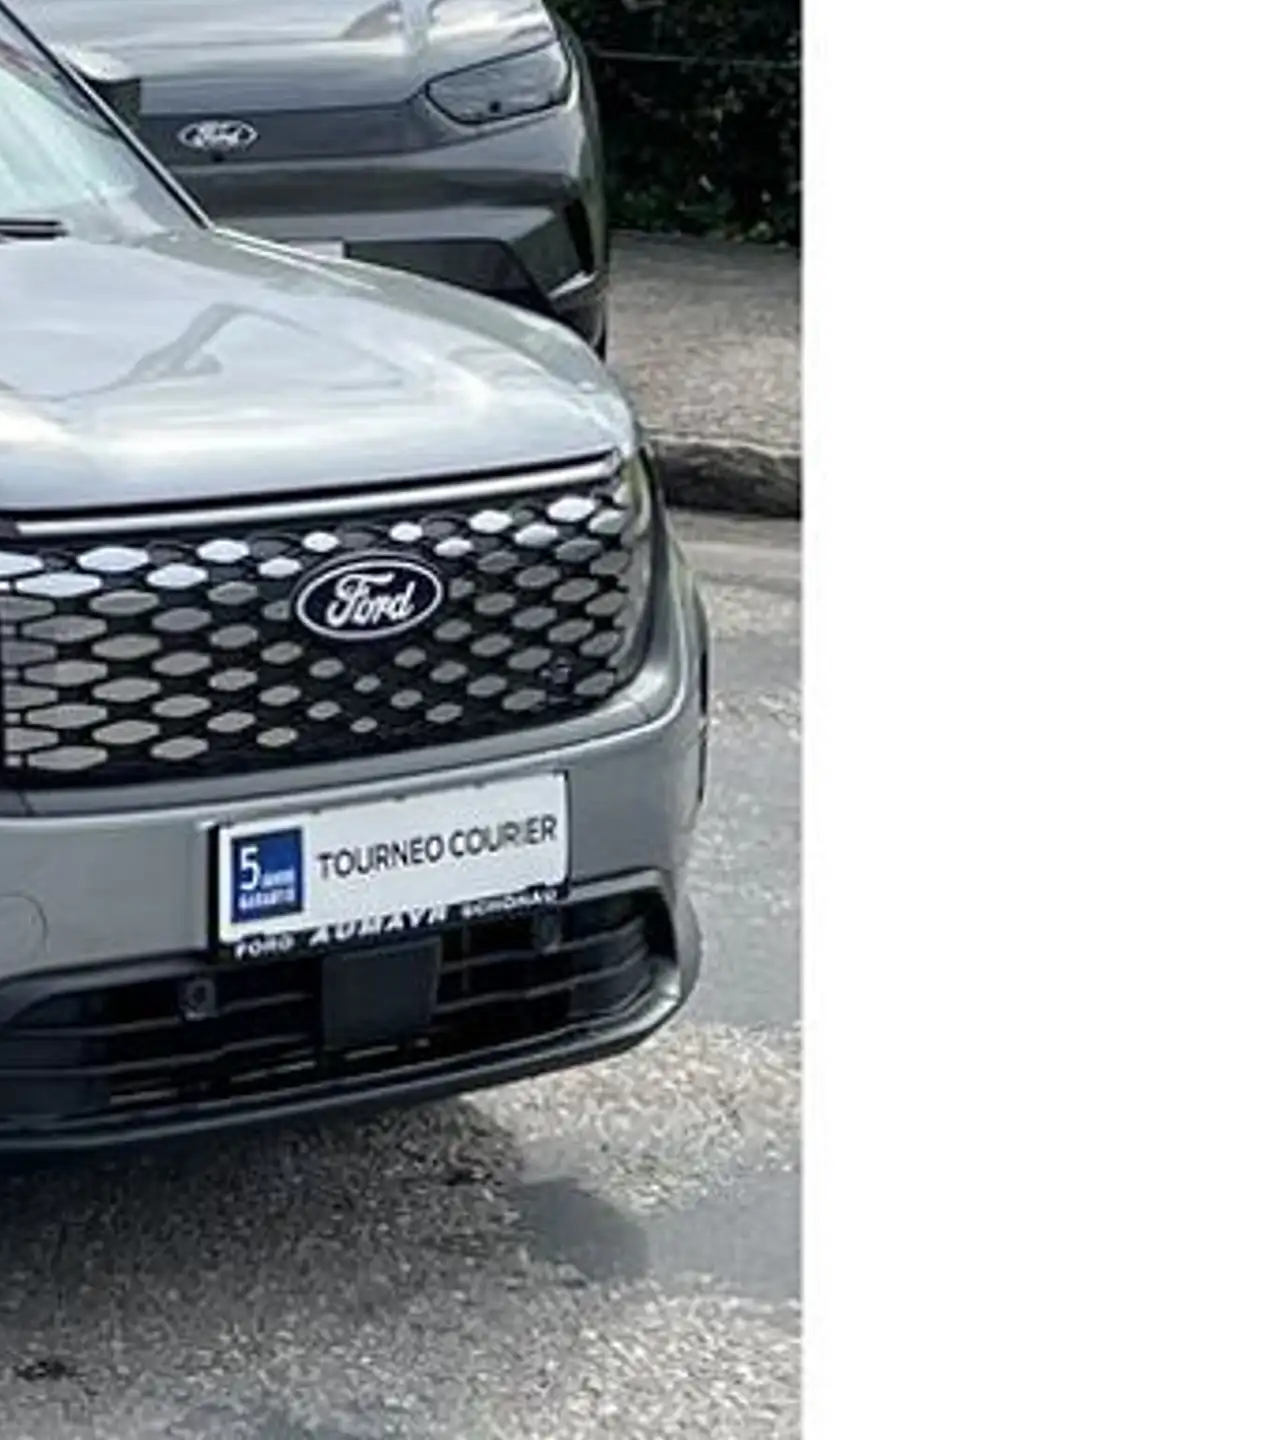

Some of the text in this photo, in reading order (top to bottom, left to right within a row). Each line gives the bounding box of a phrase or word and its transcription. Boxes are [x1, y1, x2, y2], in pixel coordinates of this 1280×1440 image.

[326, 571, 417, 628] Ford
[239, 845, 261, 891] 5
[316, 833, 445, 880] TOURNEO
[448, 813, 558, 859] COURIER
